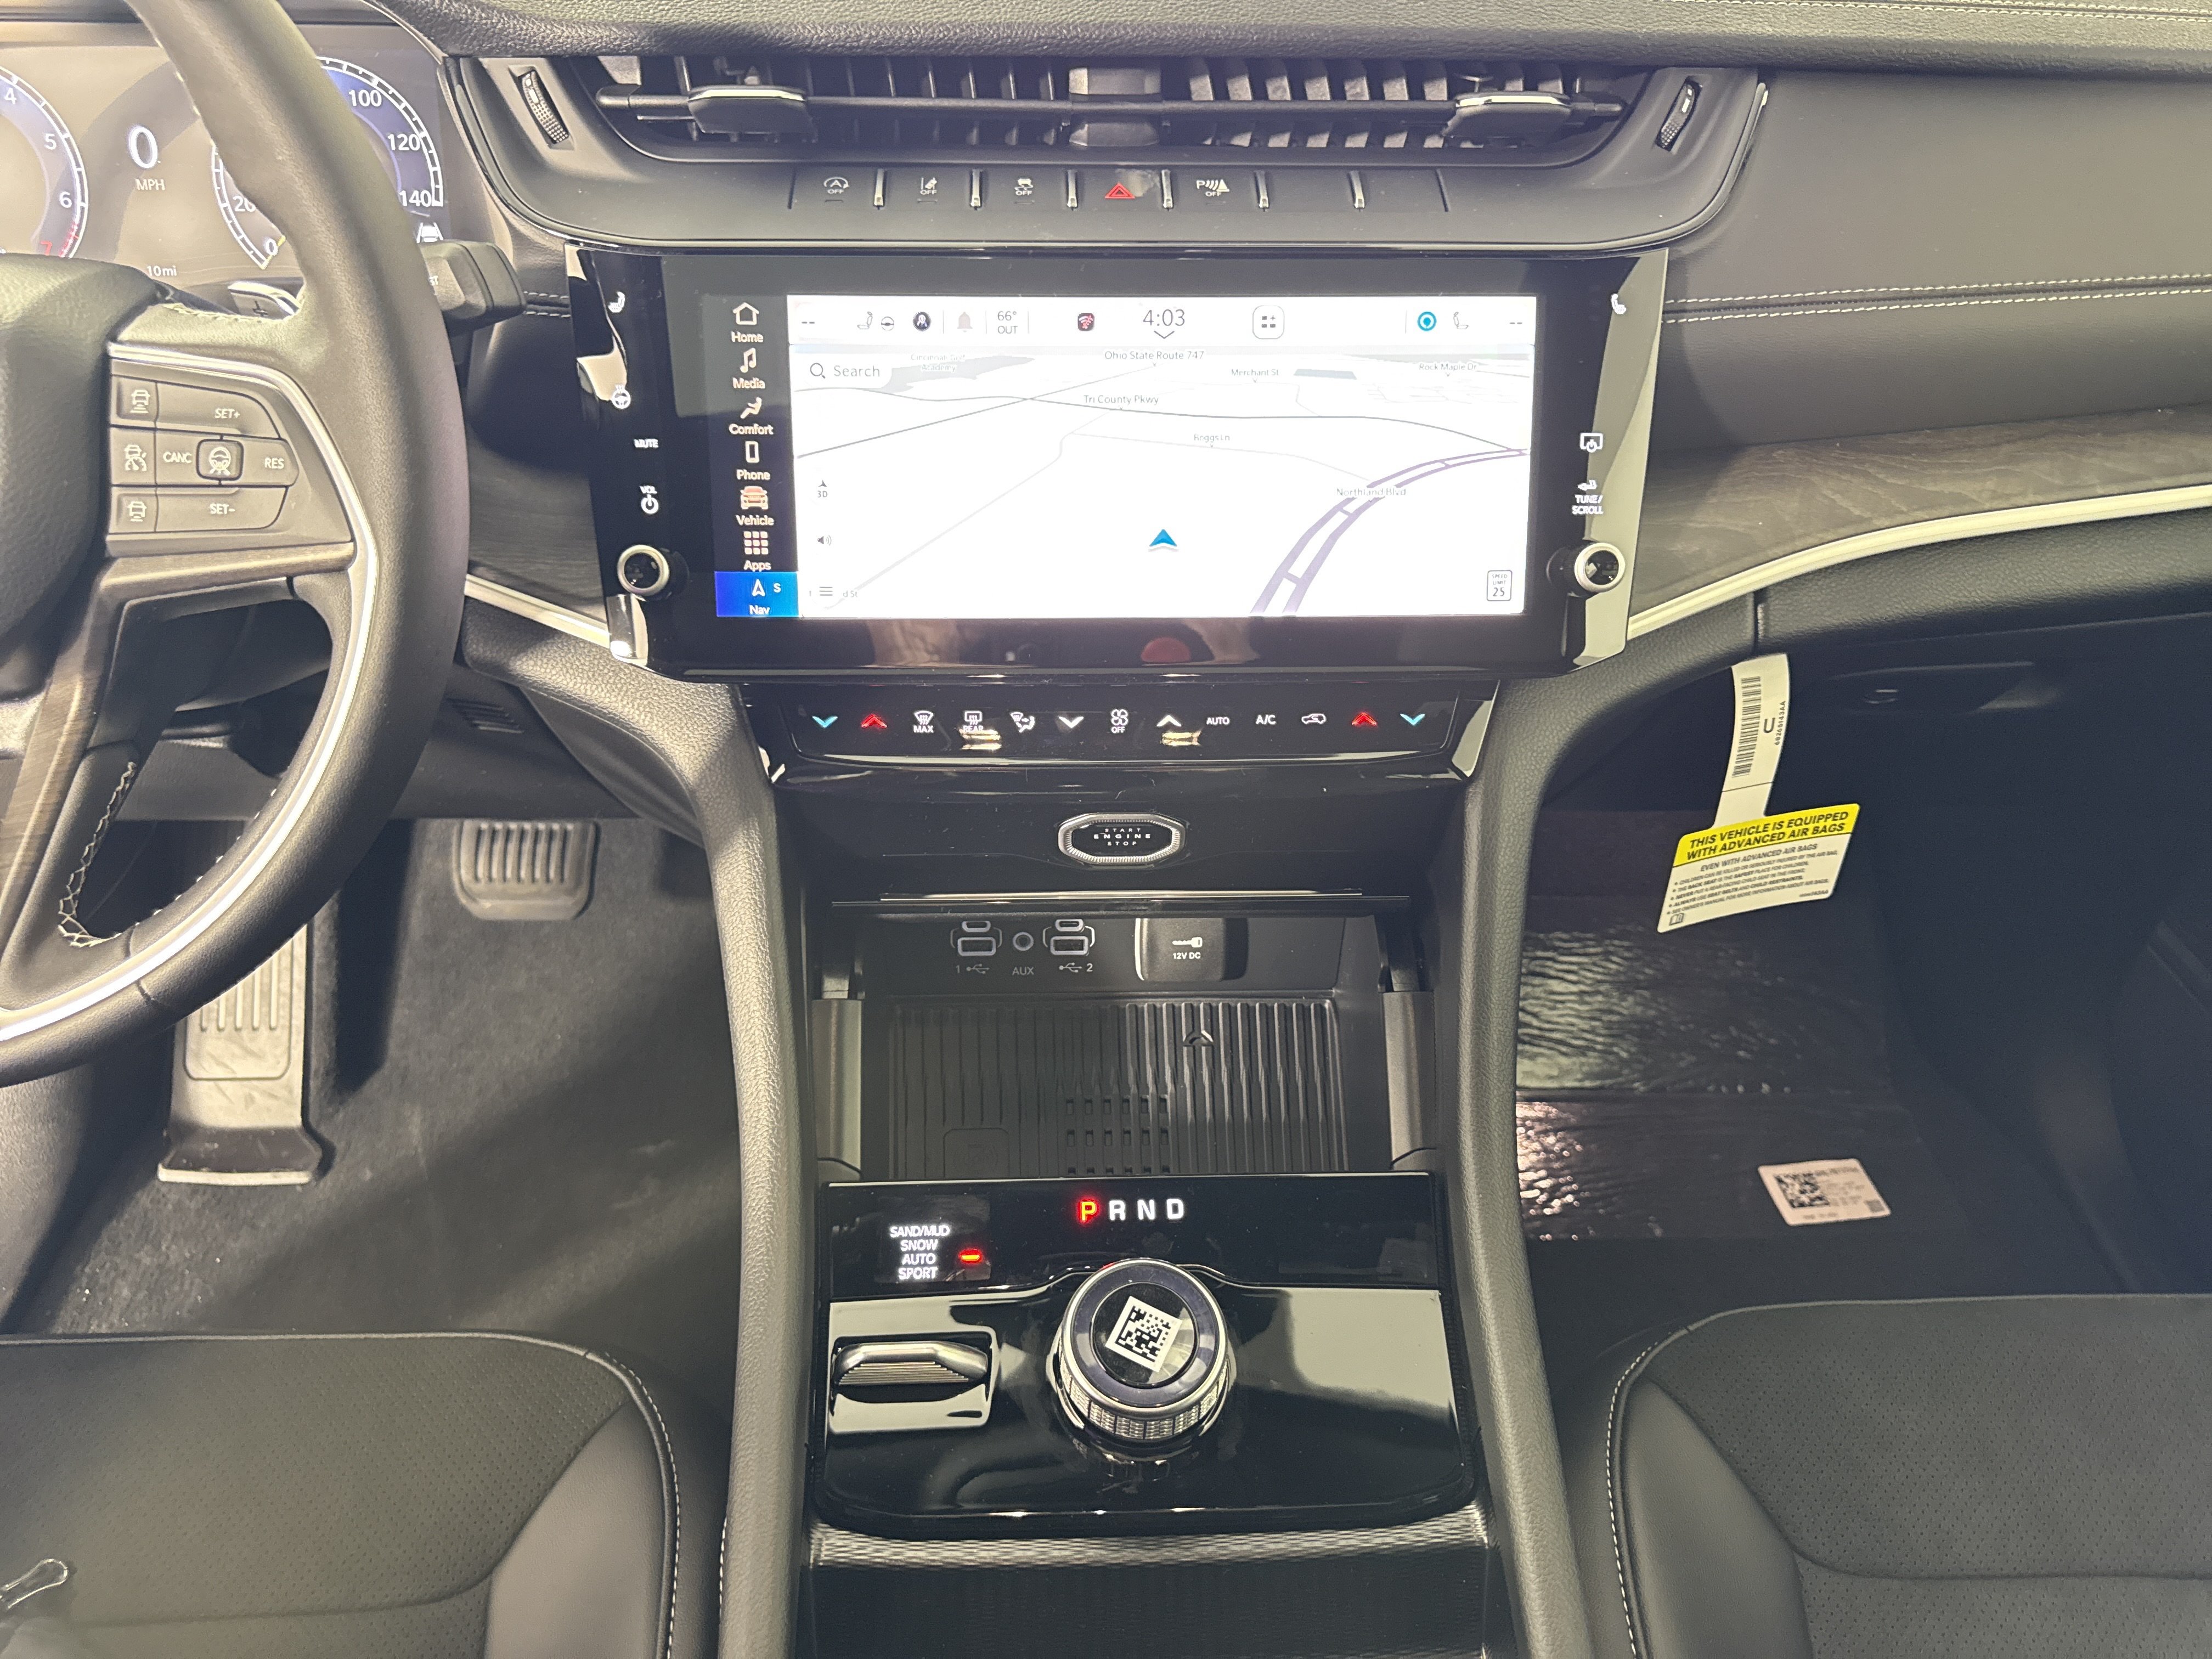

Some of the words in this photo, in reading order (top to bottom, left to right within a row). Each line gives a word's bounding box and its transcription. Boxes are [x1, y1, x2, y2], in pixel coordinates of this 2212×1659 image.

[3, 88, 17, 105] 4
[348, 89, 382, 108] 100
[44, 134, 57, 150] 5
[128, 125, 159, 169] 0
[388, 134, 420, 151] 120
[137, 179, 165, 191] MPH
[59, 192, 72, 208] 6
[234, 196, 256, 213] 20
[400, 191, 431, 207] 140
[40, 241, 53, 256] 7
[264, 239, 279, 256] 0
[146, 264, 177, 278] 10mi
[997, 311, 1017, 321] 66°
[1143, 309, 1186, 327] 4:03
[997, 325, 1018, 334] OUT
[731, 331, 764, 343] Home
[1104, 351, 1127, 359] Ohio
[1130, 351, 1154, 359] State
[1156, 351, 1184, 359] Route
[1187, 351, 1204, 359] 747
[833, 365, 881, 377] Search
[1441, 363, 1465, 371] Maple
[733, 377, 765, 389] Media
[1084, 395, 1095, 403] Tri
[1097, 395, 1131, 404] County
[1135, 395, 1159, 405] Pkwy
[215, 408, 241, 419] SET+
[729, 424, 774, 435] Comfort
[634, 439, 658, 448] MUTE
[163, 452, 192, 464] CANC
[264, 459, 285, 469] RES
[736, 470, 770, 481] Phone
[1575, 495, 1602, 505] TUNE/
[210, 504, 235, 515] SET-
[1572, 505, 1604, 515] SCROLL
[736, 515, 774, 526] Vehicle
[743, 560, 771, 572] Apps
[774, 583, 781, 592] S
[1493, 587, 1505, 597] 25
[749, 605, 770, 614] Nav
[1206, 716, 1229, 725] AUTO
[1256, 715, 1276, 725] A/C
[1764, 718, 1775, 733] U
[1690, 834, 1717, 849] THIS
[1719, 823, 1771, 841] VEHICLE
[1771, 821, 1784, 831] IS
[1786, 811, 1848, 828] EQUIPPED
[1687, 845, 1717, 860] WITH
[1719, 832, 1786, 853] ADVANCED
[1787, 827, 1809, 838] AIR
[1812, 823, 1846, 834] BAGS
[1701, 862, 1719, 871] EVEN
[1722, 857, 1740, 866] WITH
[1741, 849, 1782, 862] ADVANCED
[1797, 843, 1818, 852] BAGS
[956, 965, 960, 973] 1
[1012, 966, 1034, 975] AUX
[1086, 963, 1093, 972] 2
[1080, 1200, 1097, 1222] P
[1109, 1200, 1126, 1221] R
[1137, 1200, 1155, 1220] N
[1166, 1199, 1184, 1220] D
[890, 1225, 950, 1238] SAND/MUD
[900, 1240, 938, 1251] SNOW
[902, 1254, 936, 1265] AUTO
[898, 1267, 938, 1280] SPORT
